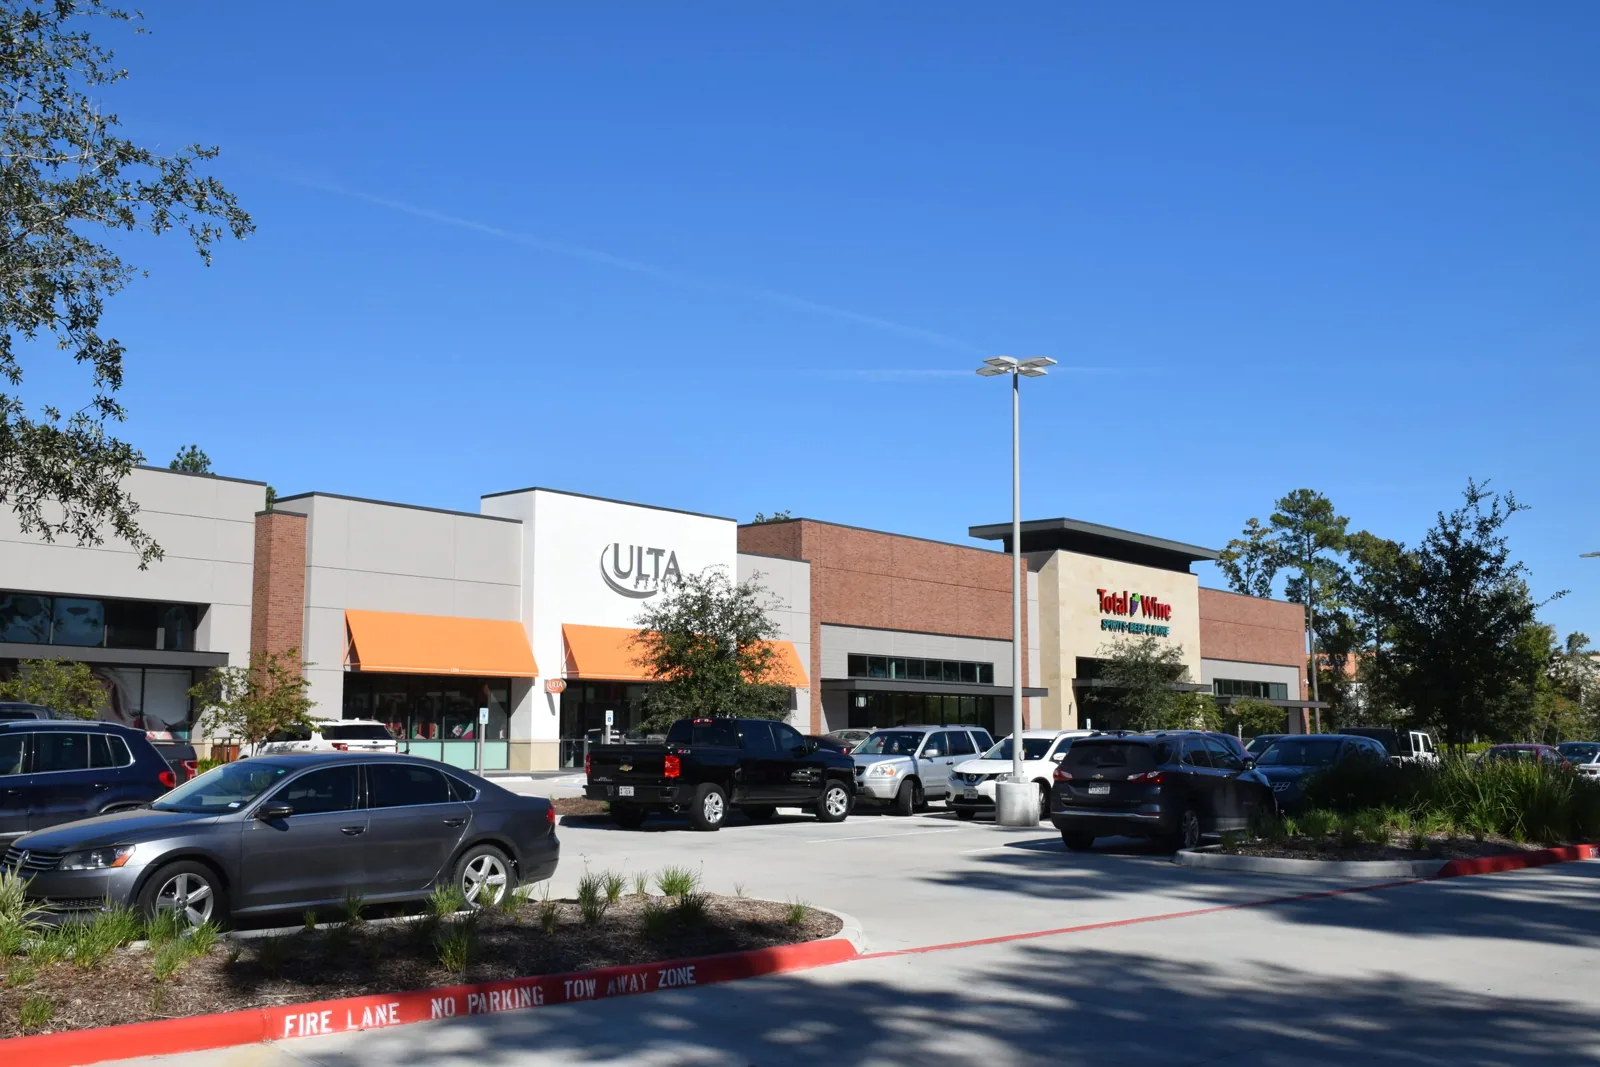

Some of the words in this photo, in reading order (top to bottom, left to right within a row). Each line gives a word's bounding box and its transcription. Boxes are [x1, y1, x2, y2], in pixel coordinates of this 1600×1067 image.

[613, 542, 683, 583] ULTA
[1097, 588, 1128, 615] Total
[1140, 595, 1171, 621] Wine
[284, 1010, 333, 1037] FIRE
[347, 1003, 400, 1029] LANE
[431, 997, 456, 1019] NO
[467, 986, 545, 1015] PARKING
[564, 979, 597, 1000] TOW
[606, 972, 648, 995] AWAY
[657, 966, 697, 988] ZONE
